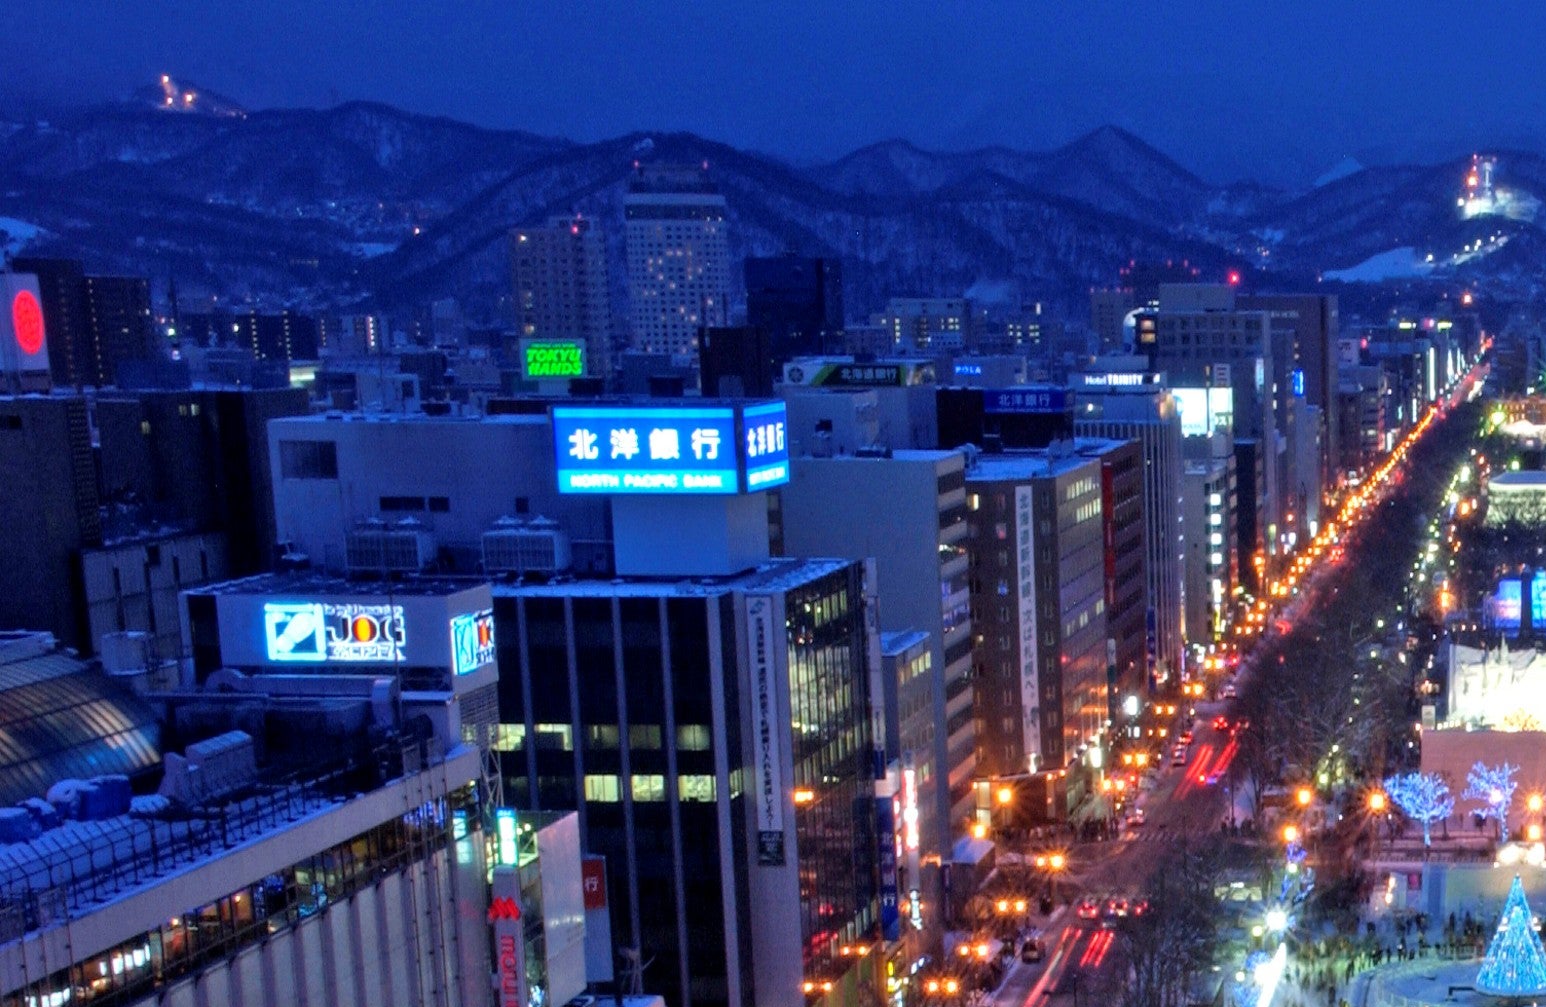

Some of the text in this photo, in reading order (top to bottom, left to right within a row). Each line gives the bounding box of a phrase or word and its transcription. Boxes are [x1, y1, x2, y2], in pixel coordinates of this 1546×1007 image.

[527, 349, 582, 362] TOKYU
[528, 362, 582, 376] HANDS
[955, 366, 982, 375] POLA
[568, 428, 721, 460] 北洋銀行
[570, 473, 723, 488] NORTH PACIFIC BANK
